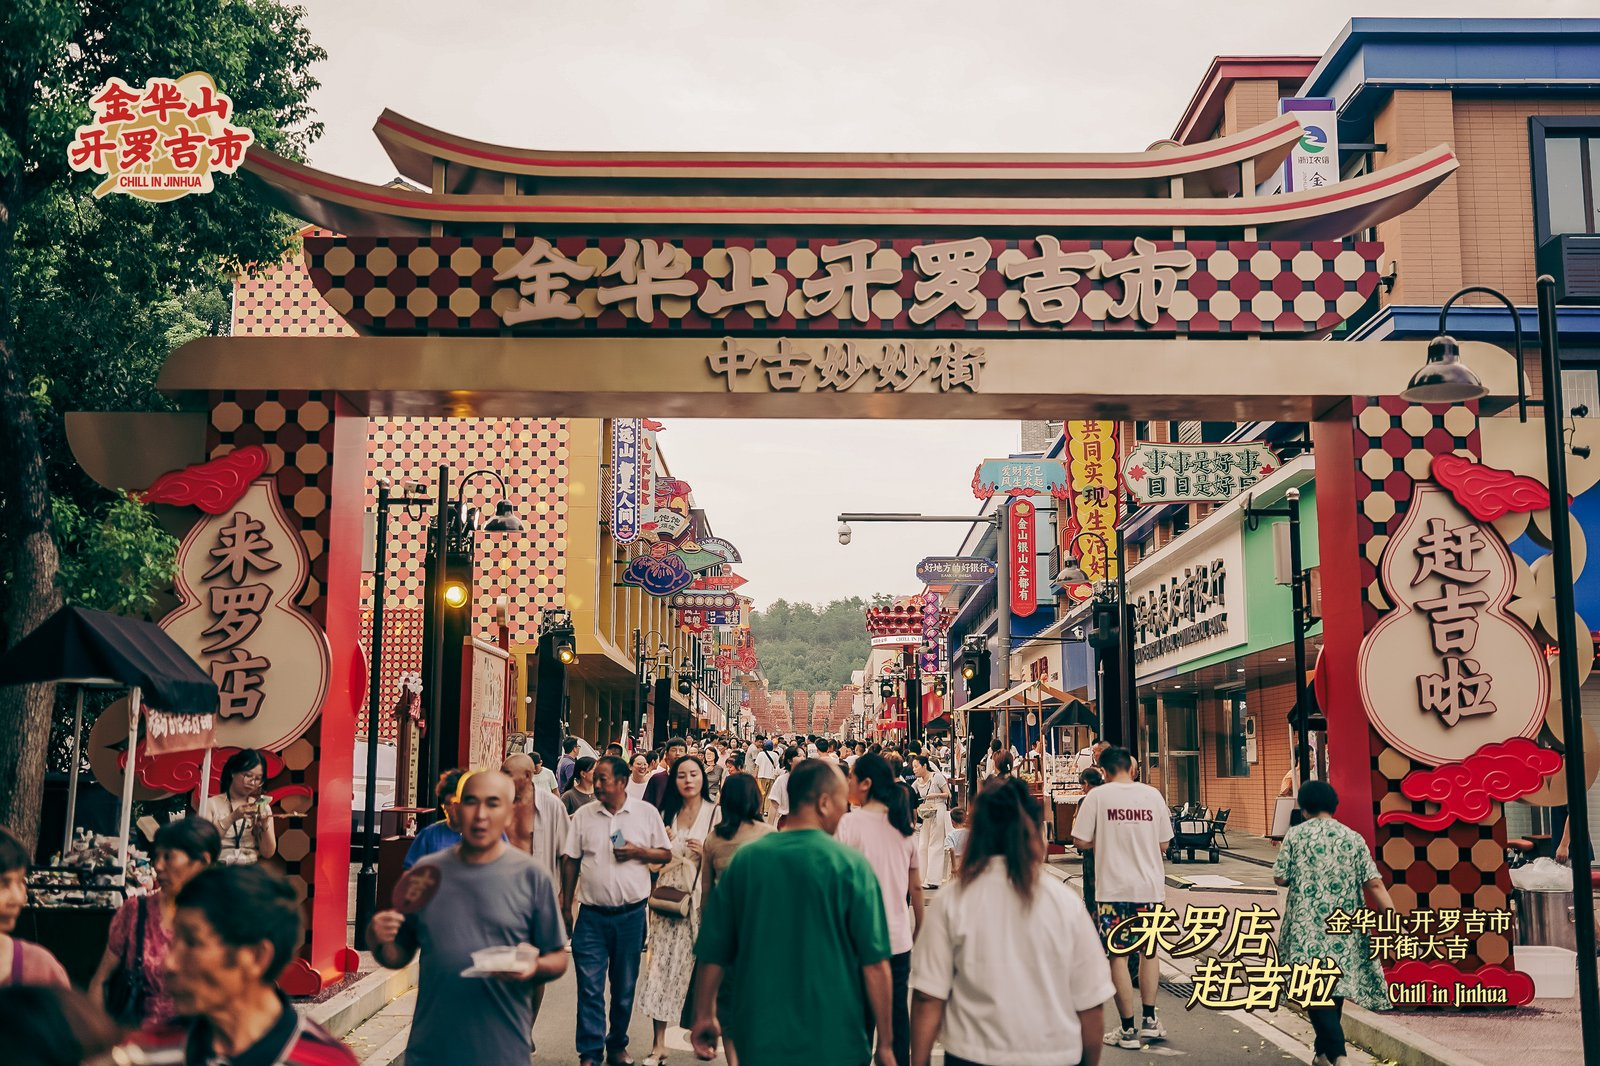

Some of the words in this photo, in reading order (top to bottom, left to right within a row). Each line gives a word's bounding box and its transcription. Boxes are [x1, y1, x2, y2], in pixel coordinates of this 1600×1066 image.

[494, 234, 1197, 327] 金华山开罗吉市
[706, 336, 988, 393] 中古妙妙街
[1001, 476, 1044, 488] 风生水起
[1143, 448, 1262, 475] 事事是好事
[924, 562, 989, 573] 好地方的好银行
[1017, 517, 1031, 601] 金山银山全都有
[201, 511, 283, 721] 来罗店
[1410, 518, 1498, 728] 赶吉啦
[1107, 808, 1153, 822] MSONES
